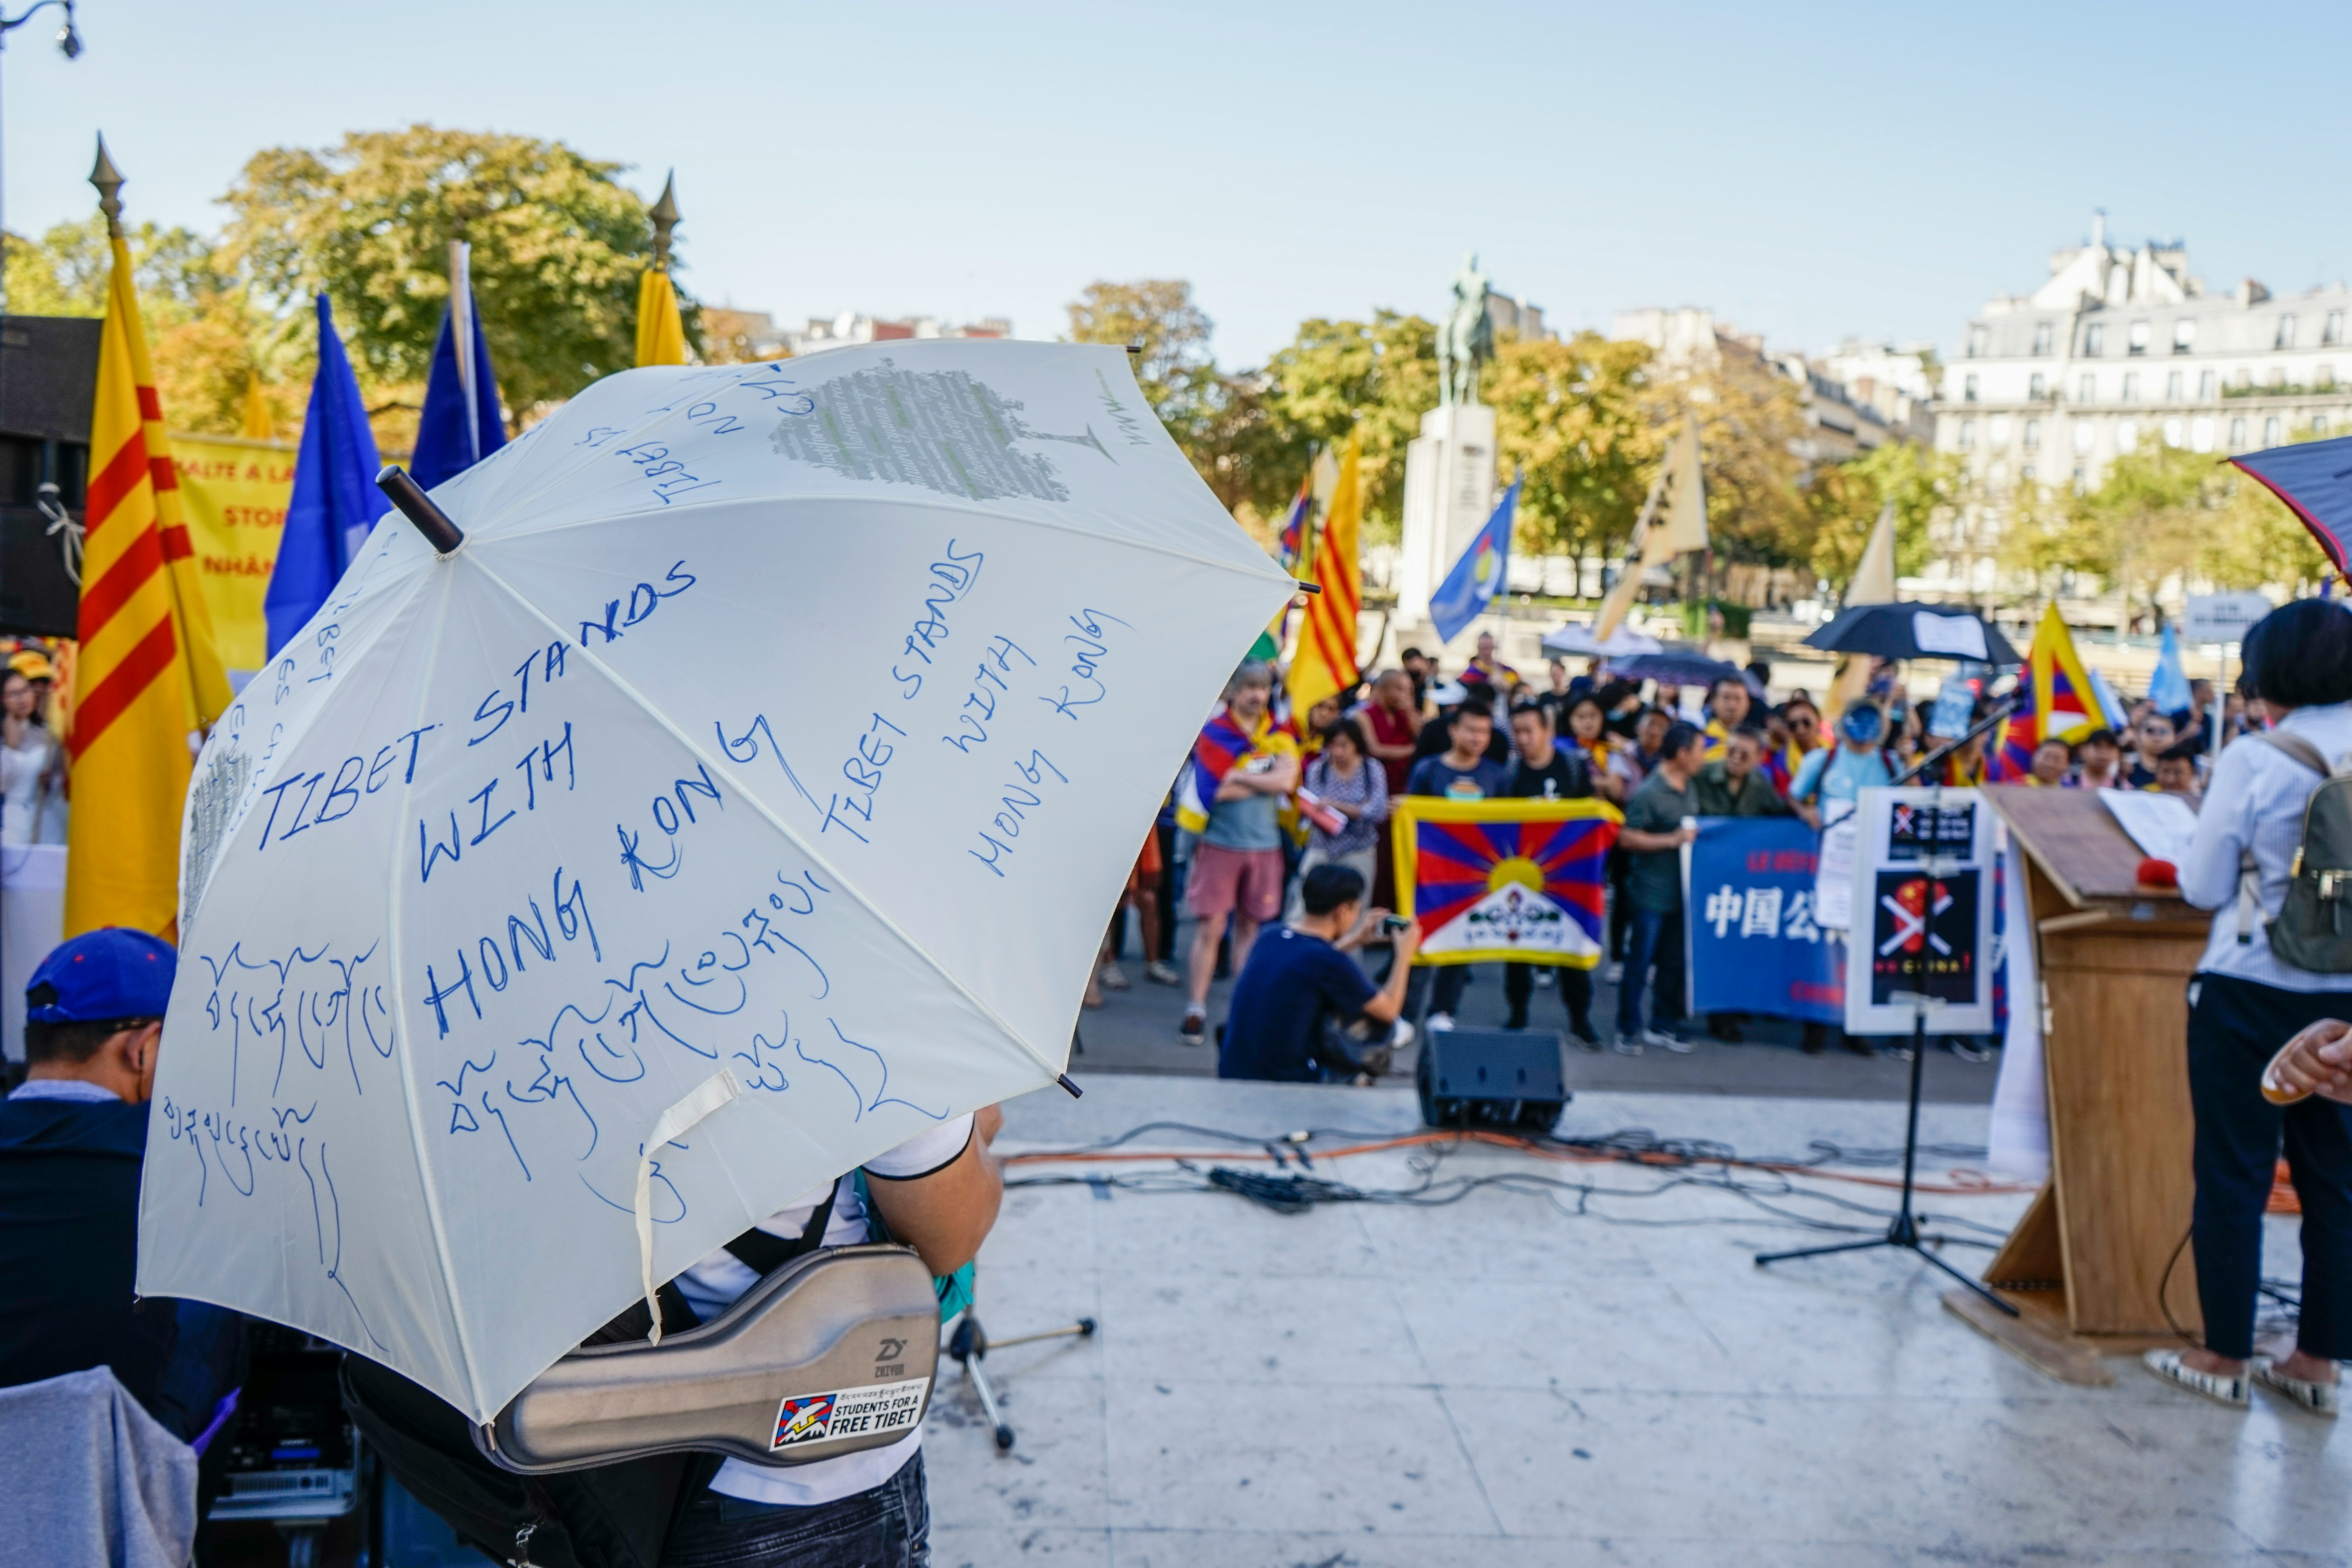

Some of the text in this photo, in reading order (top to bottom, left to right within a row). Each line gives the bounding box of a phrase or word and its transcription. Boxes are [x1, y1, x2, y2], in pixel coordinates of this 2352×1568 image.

[615, 440, 723, 505] TIBET
[258, 722, 444, 852] TIBET
[466, 559, 698, 746] STANDS
[821, 712, 908, 844] TIBET
[892, 538, 984, 700] STANDS
[942, 635, 1037, 754] WITH
[967, 608, 1139, 877] HONG KONG
[418, 721, 574, 884] WITH
[423, 713, 823, 1040] HONG KONG
[1706, 885, 1850, 944] 中国公
[831, 1408, 916, 1435] FREE TIBET
[836, 1395, 919, 1416] STUDENTS FOR A
[875, 1364, 904, 1378] ZHIYUN
